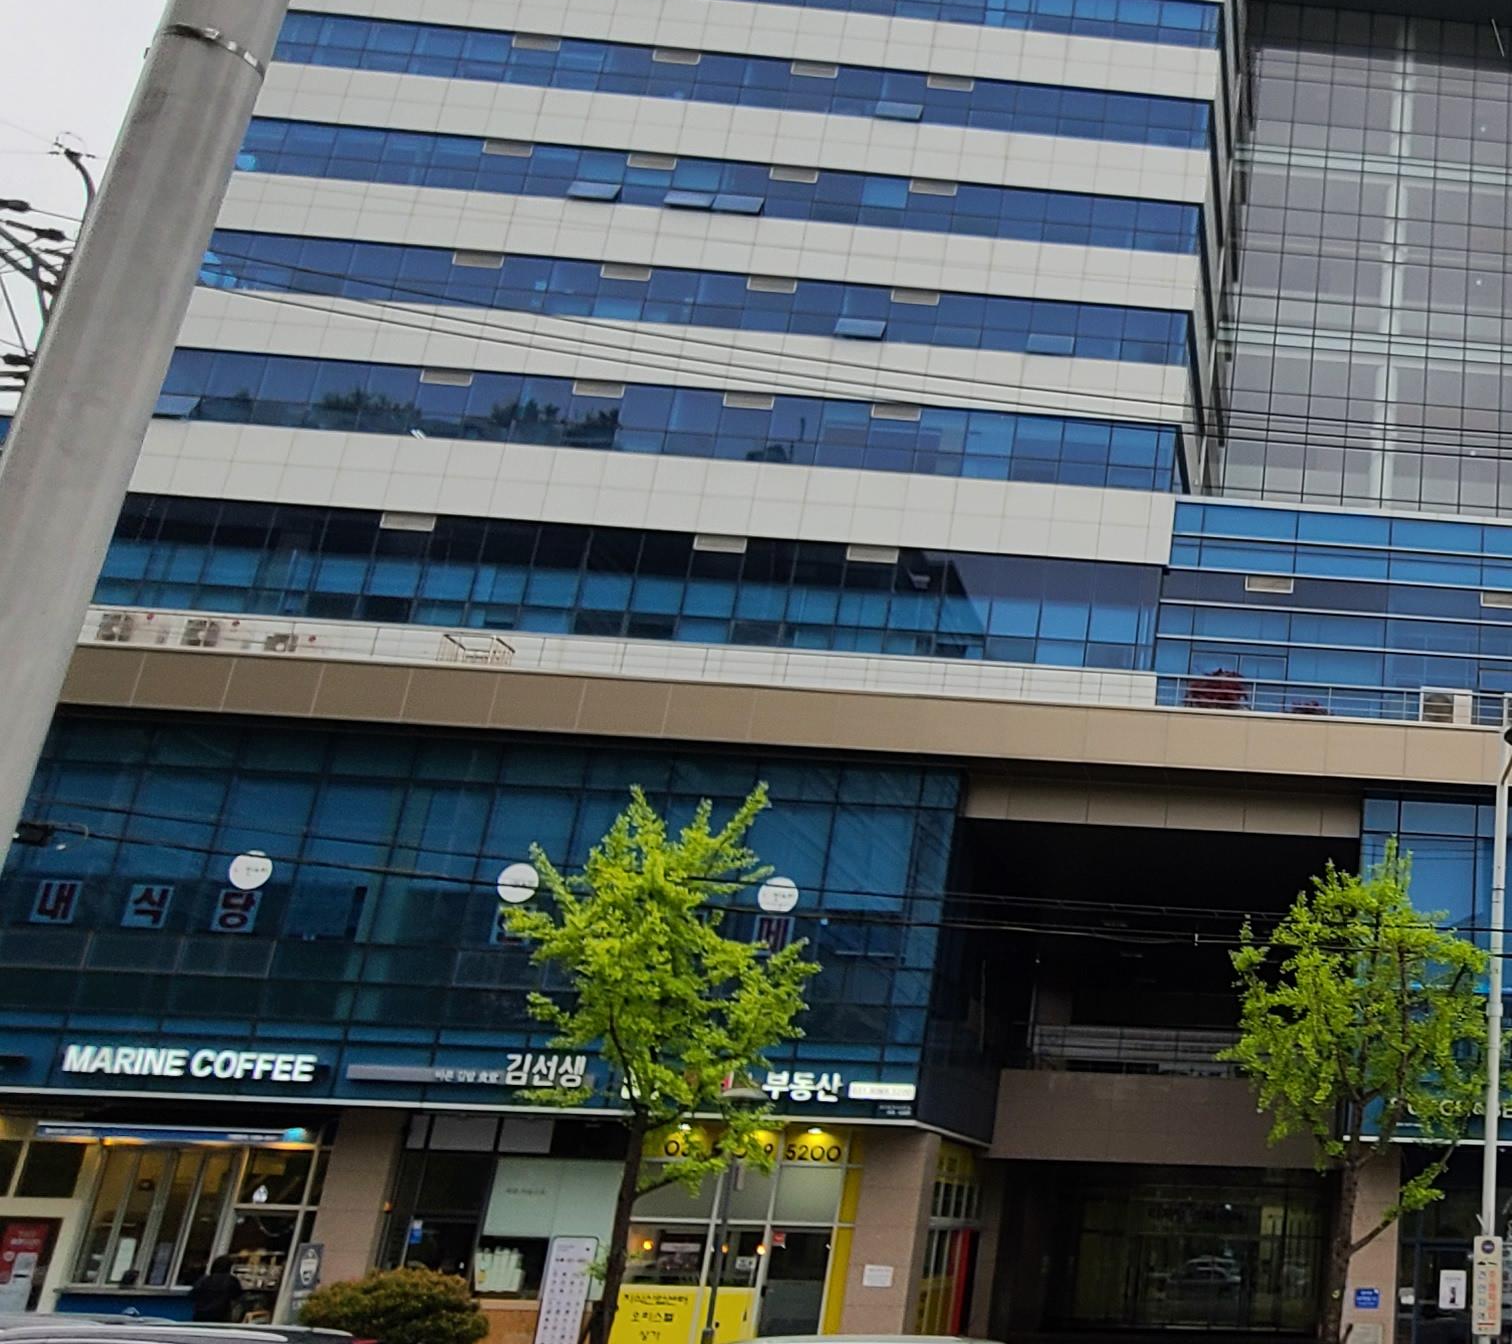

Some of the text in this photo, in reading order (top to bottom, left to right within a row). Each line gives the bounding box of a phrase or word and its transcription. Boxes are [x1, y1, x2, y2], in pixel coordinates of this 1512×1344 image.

[62, 1044, 317, 1083] MARINE COFFEE
[505, 1053, 586, 1088] 김선생
[762, 1071, 842, 1103] 부동산
[786, 1144, 842, 1162] 5200
